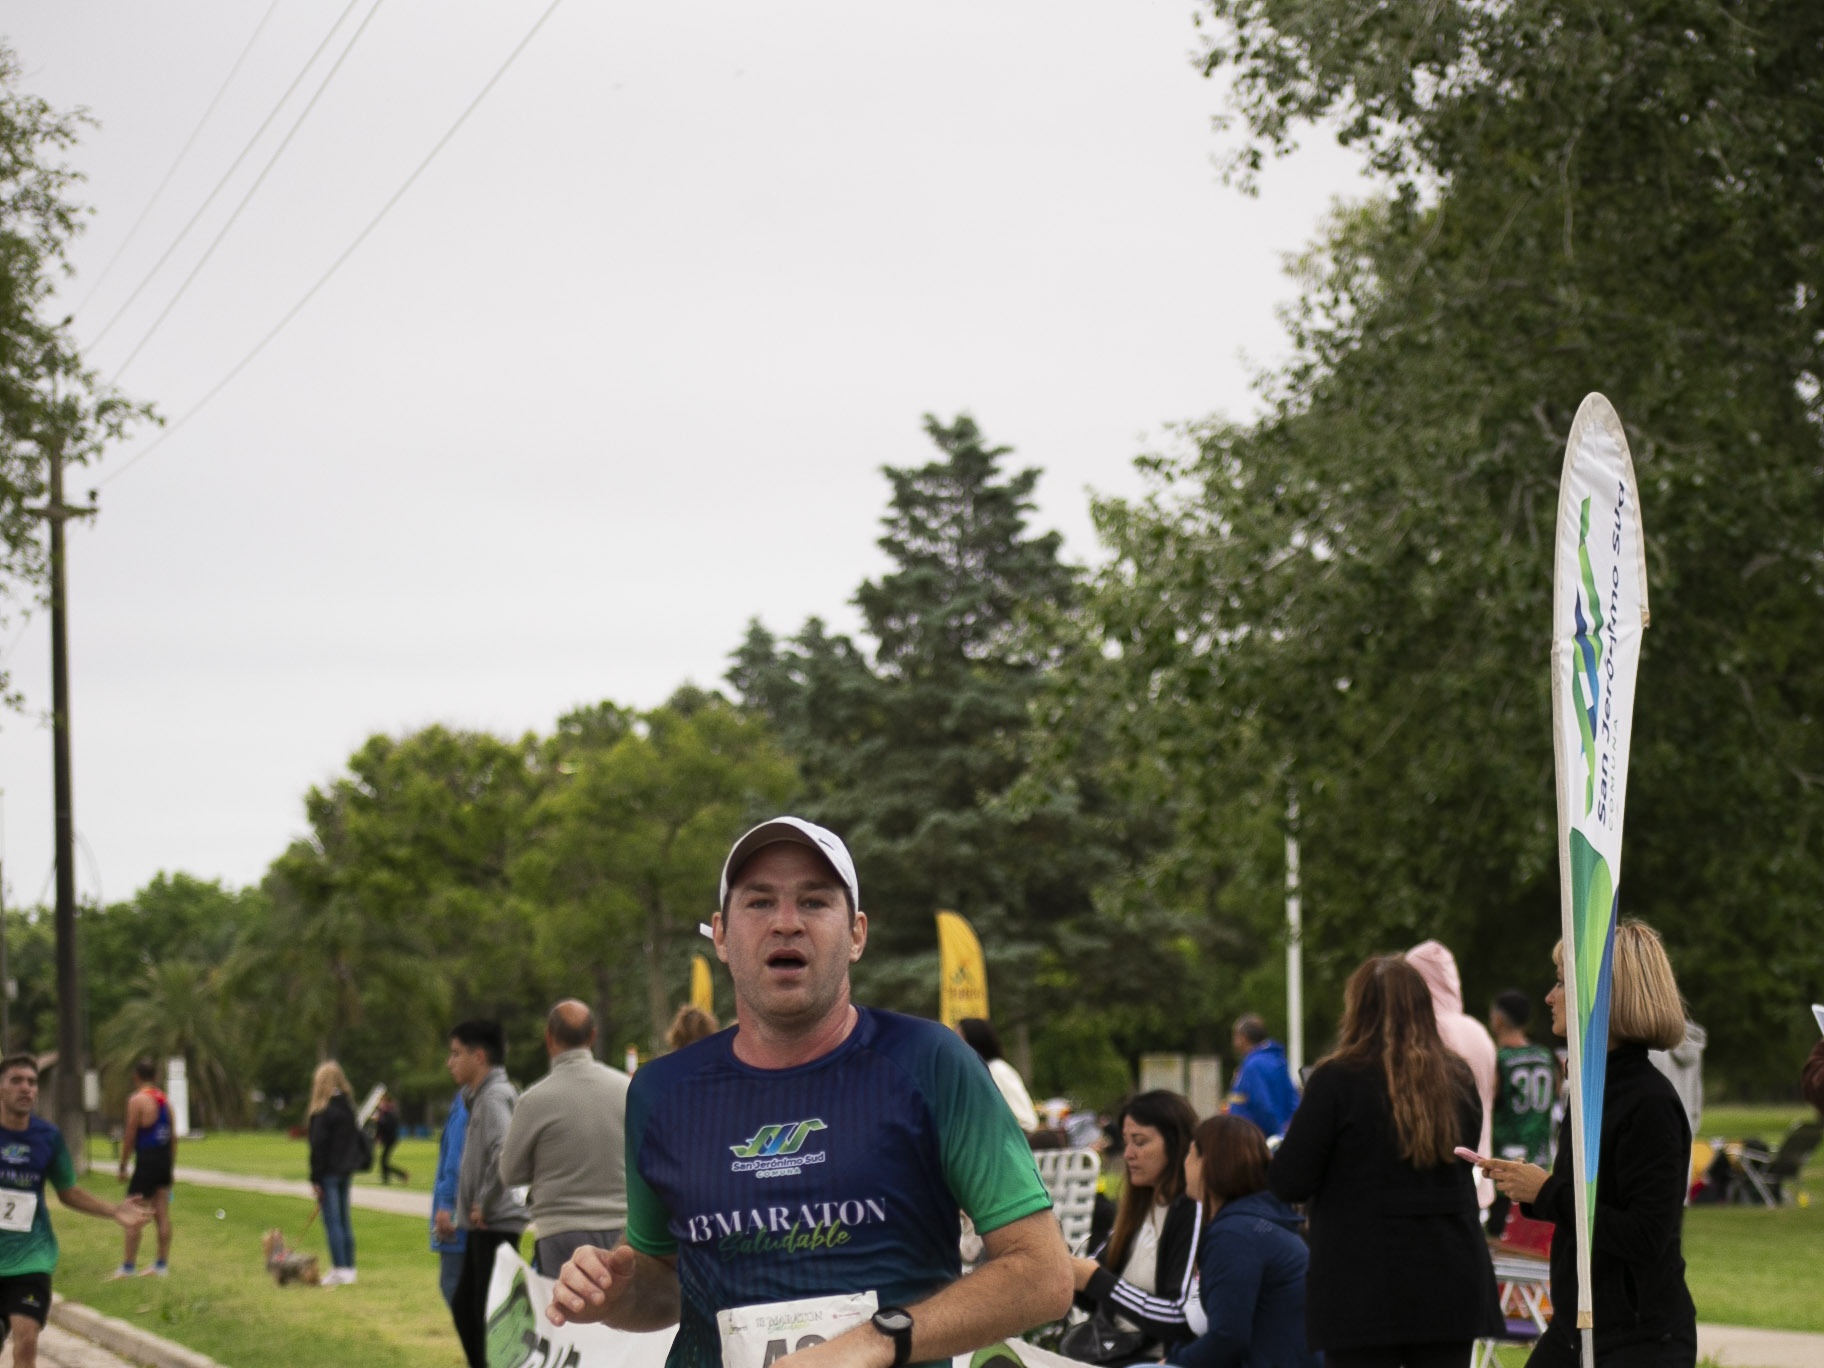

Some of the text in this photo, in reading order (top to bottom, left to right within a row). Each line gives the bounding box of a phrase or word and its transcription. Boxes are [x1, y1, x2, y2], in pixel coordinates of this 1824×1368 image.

[1598, 752, 1608, 825] San
[1608, 719, 1618, 831] COMUNA
[1512, 1067, 1552, 1114] 30
[731, 1160, 757, 1172] San
[804, 1151, 826, 1165] Sud
[756, 1167, 802, 1178] COMUNA
[714, 1197, 886, 1239] MARATON
[718, 1218, 852, 1260] Saludable
